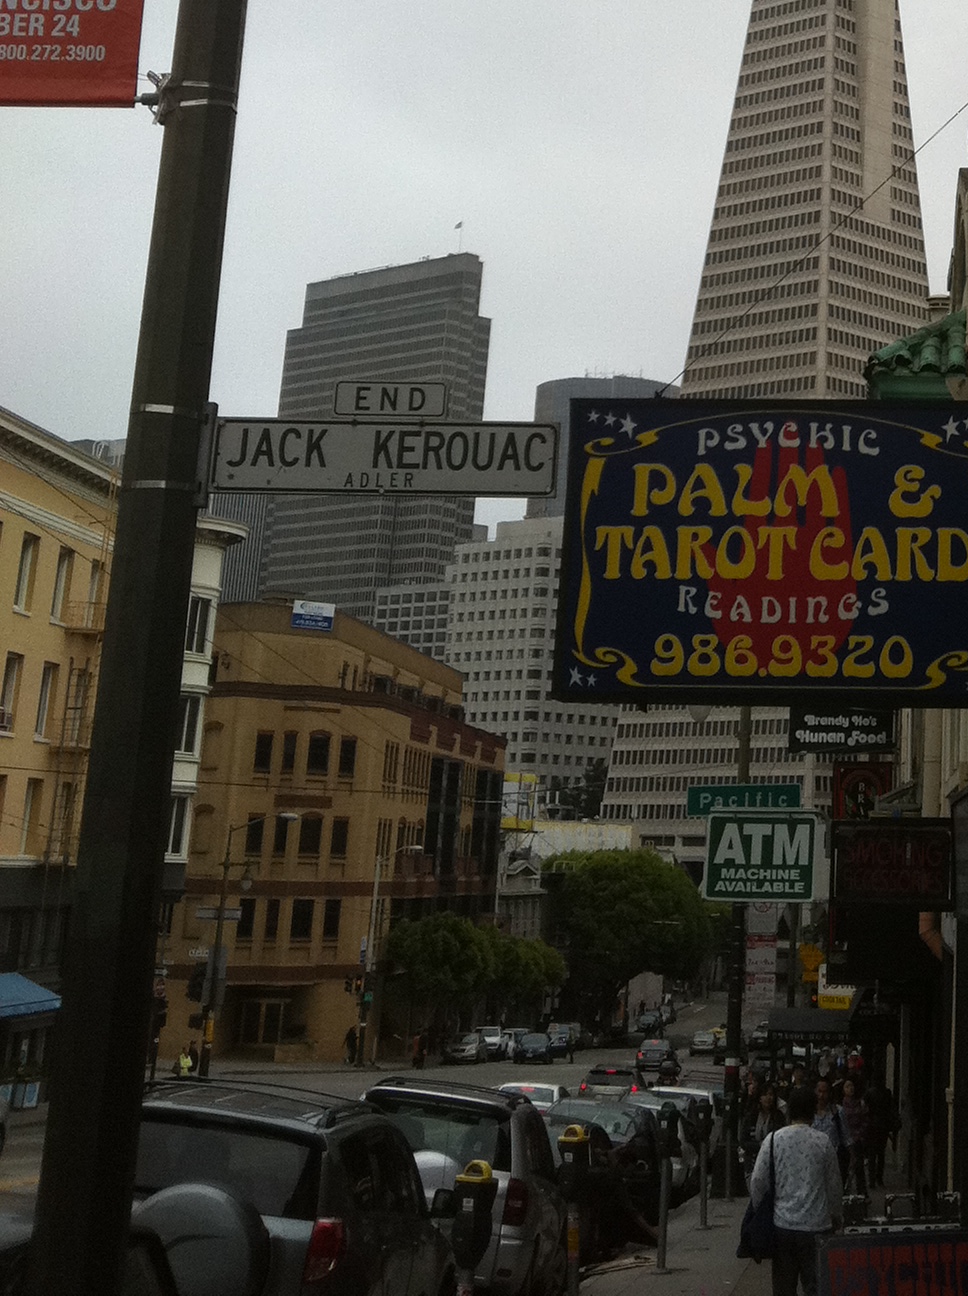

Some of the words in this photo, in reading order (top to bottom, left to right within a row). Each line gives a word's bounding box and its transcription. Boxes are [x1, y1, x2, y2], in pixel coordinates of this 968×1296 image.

[51, 14, 80, 37] 24
[355, 386, 426, 412] END
[226, 427, 327, 468] JACK
[371, 430, 547, 472] KEROUAC
[696, 421, 881, 456] PSYCHIC
[344, 472, 414, 488] ADLER
[630, 463, 840, 518] PALM
[887, 465, 942, 518] &
[594, 525, 798, 581] TAROT
[677, 585, 889, 625] READINGS
[650, 634, 914, 678] 986.9320
[803, 714, 849, 728] Brandy
[851, 714, 878, 726] Ho's
[795, 729, 845, 743] Hunan
[847, 730, 887, 746] Food
[700, 791, 788, 808] Pacific
[713, 823, 811, 865] ATM
[714, 880, 805, 893] AVAILABLE
[721, 868, 801, 880] MACHINE
